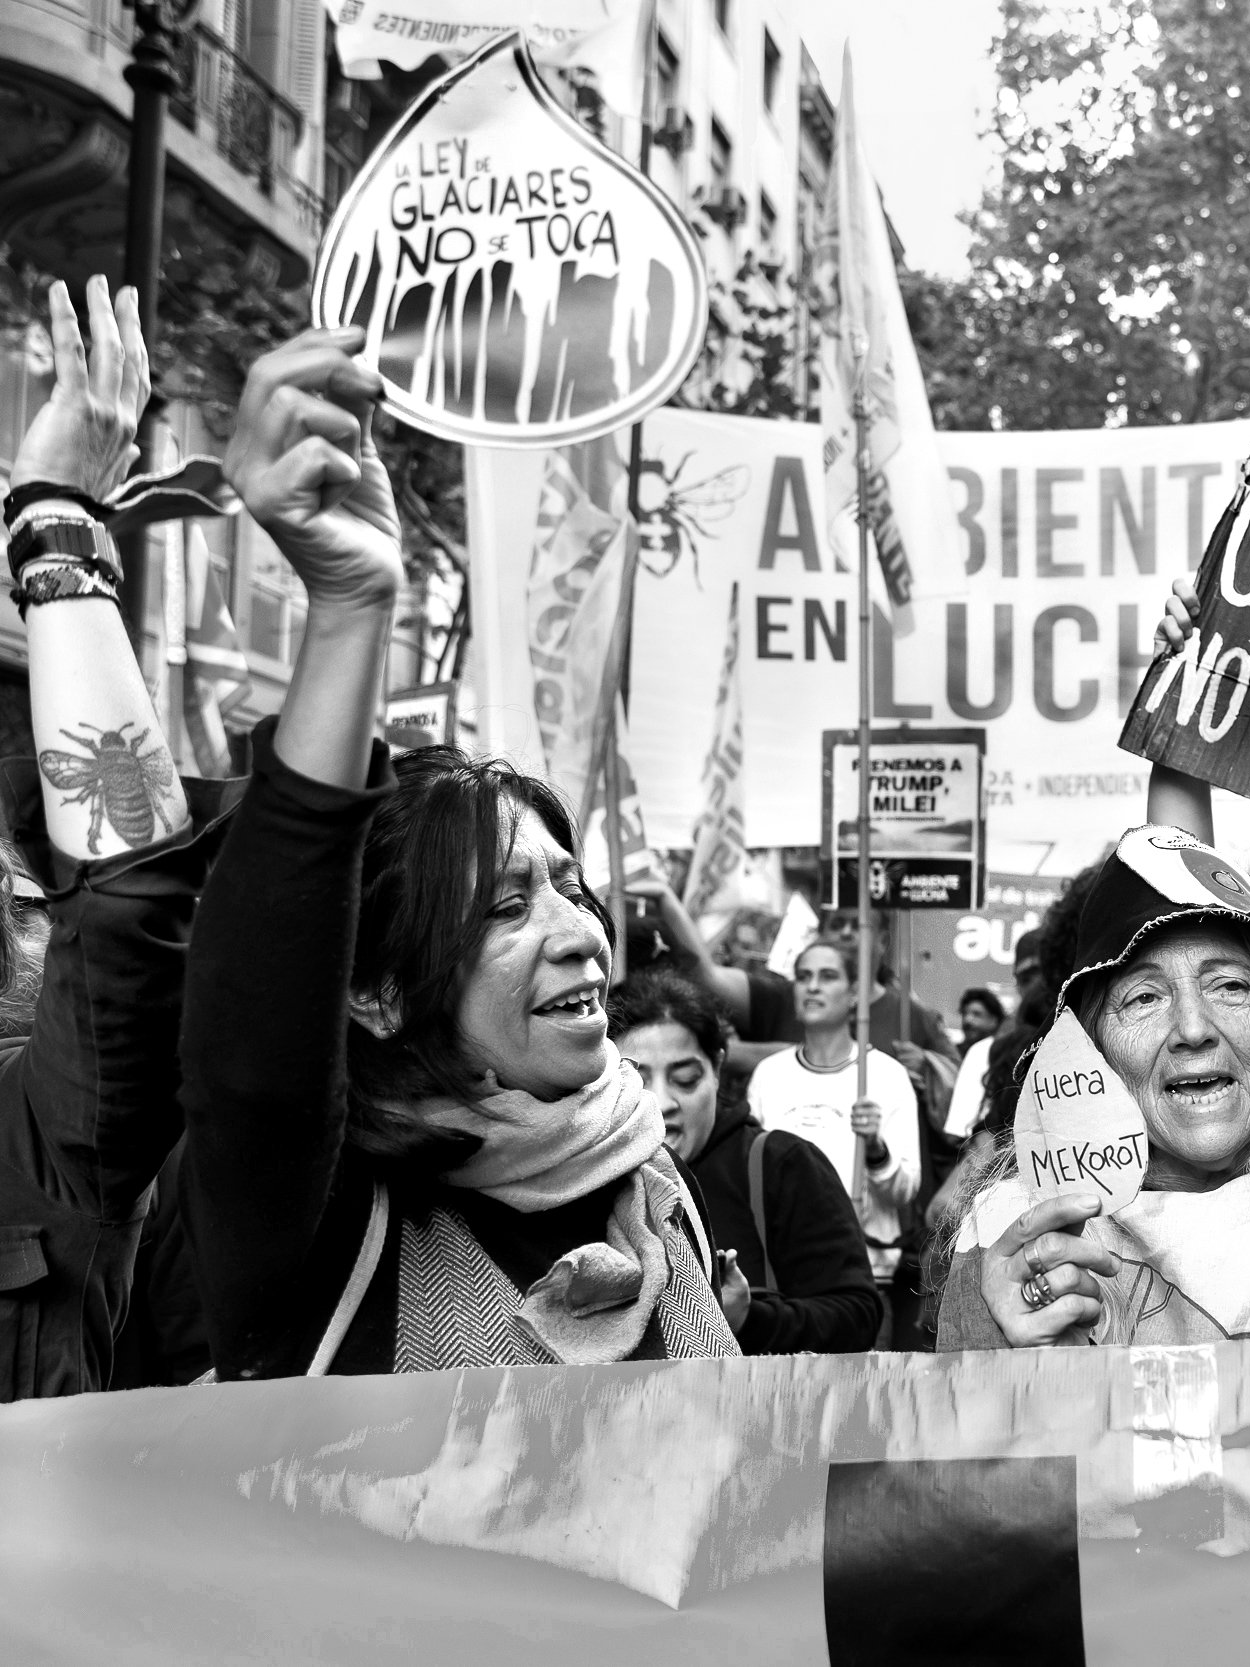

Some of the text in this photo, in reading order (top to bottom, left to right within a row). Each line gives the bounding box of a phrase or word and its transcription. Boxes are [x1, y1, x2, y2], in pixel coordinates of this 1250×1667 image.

[395, 137, 491, 180] LA LEY DE
[391, 165, 592, 231] GLACIARES
[396, 210, 619, 280] NO SE TOCA
[755, 596, 847, 662] EN
[852, 758, 963, 773] FENEMOS A
[873, 795, 937, 812] MILEI
[1033, 1069, 1105, 1111] fuera
[1031, 1132, 1145, 1196] MEKOROT
